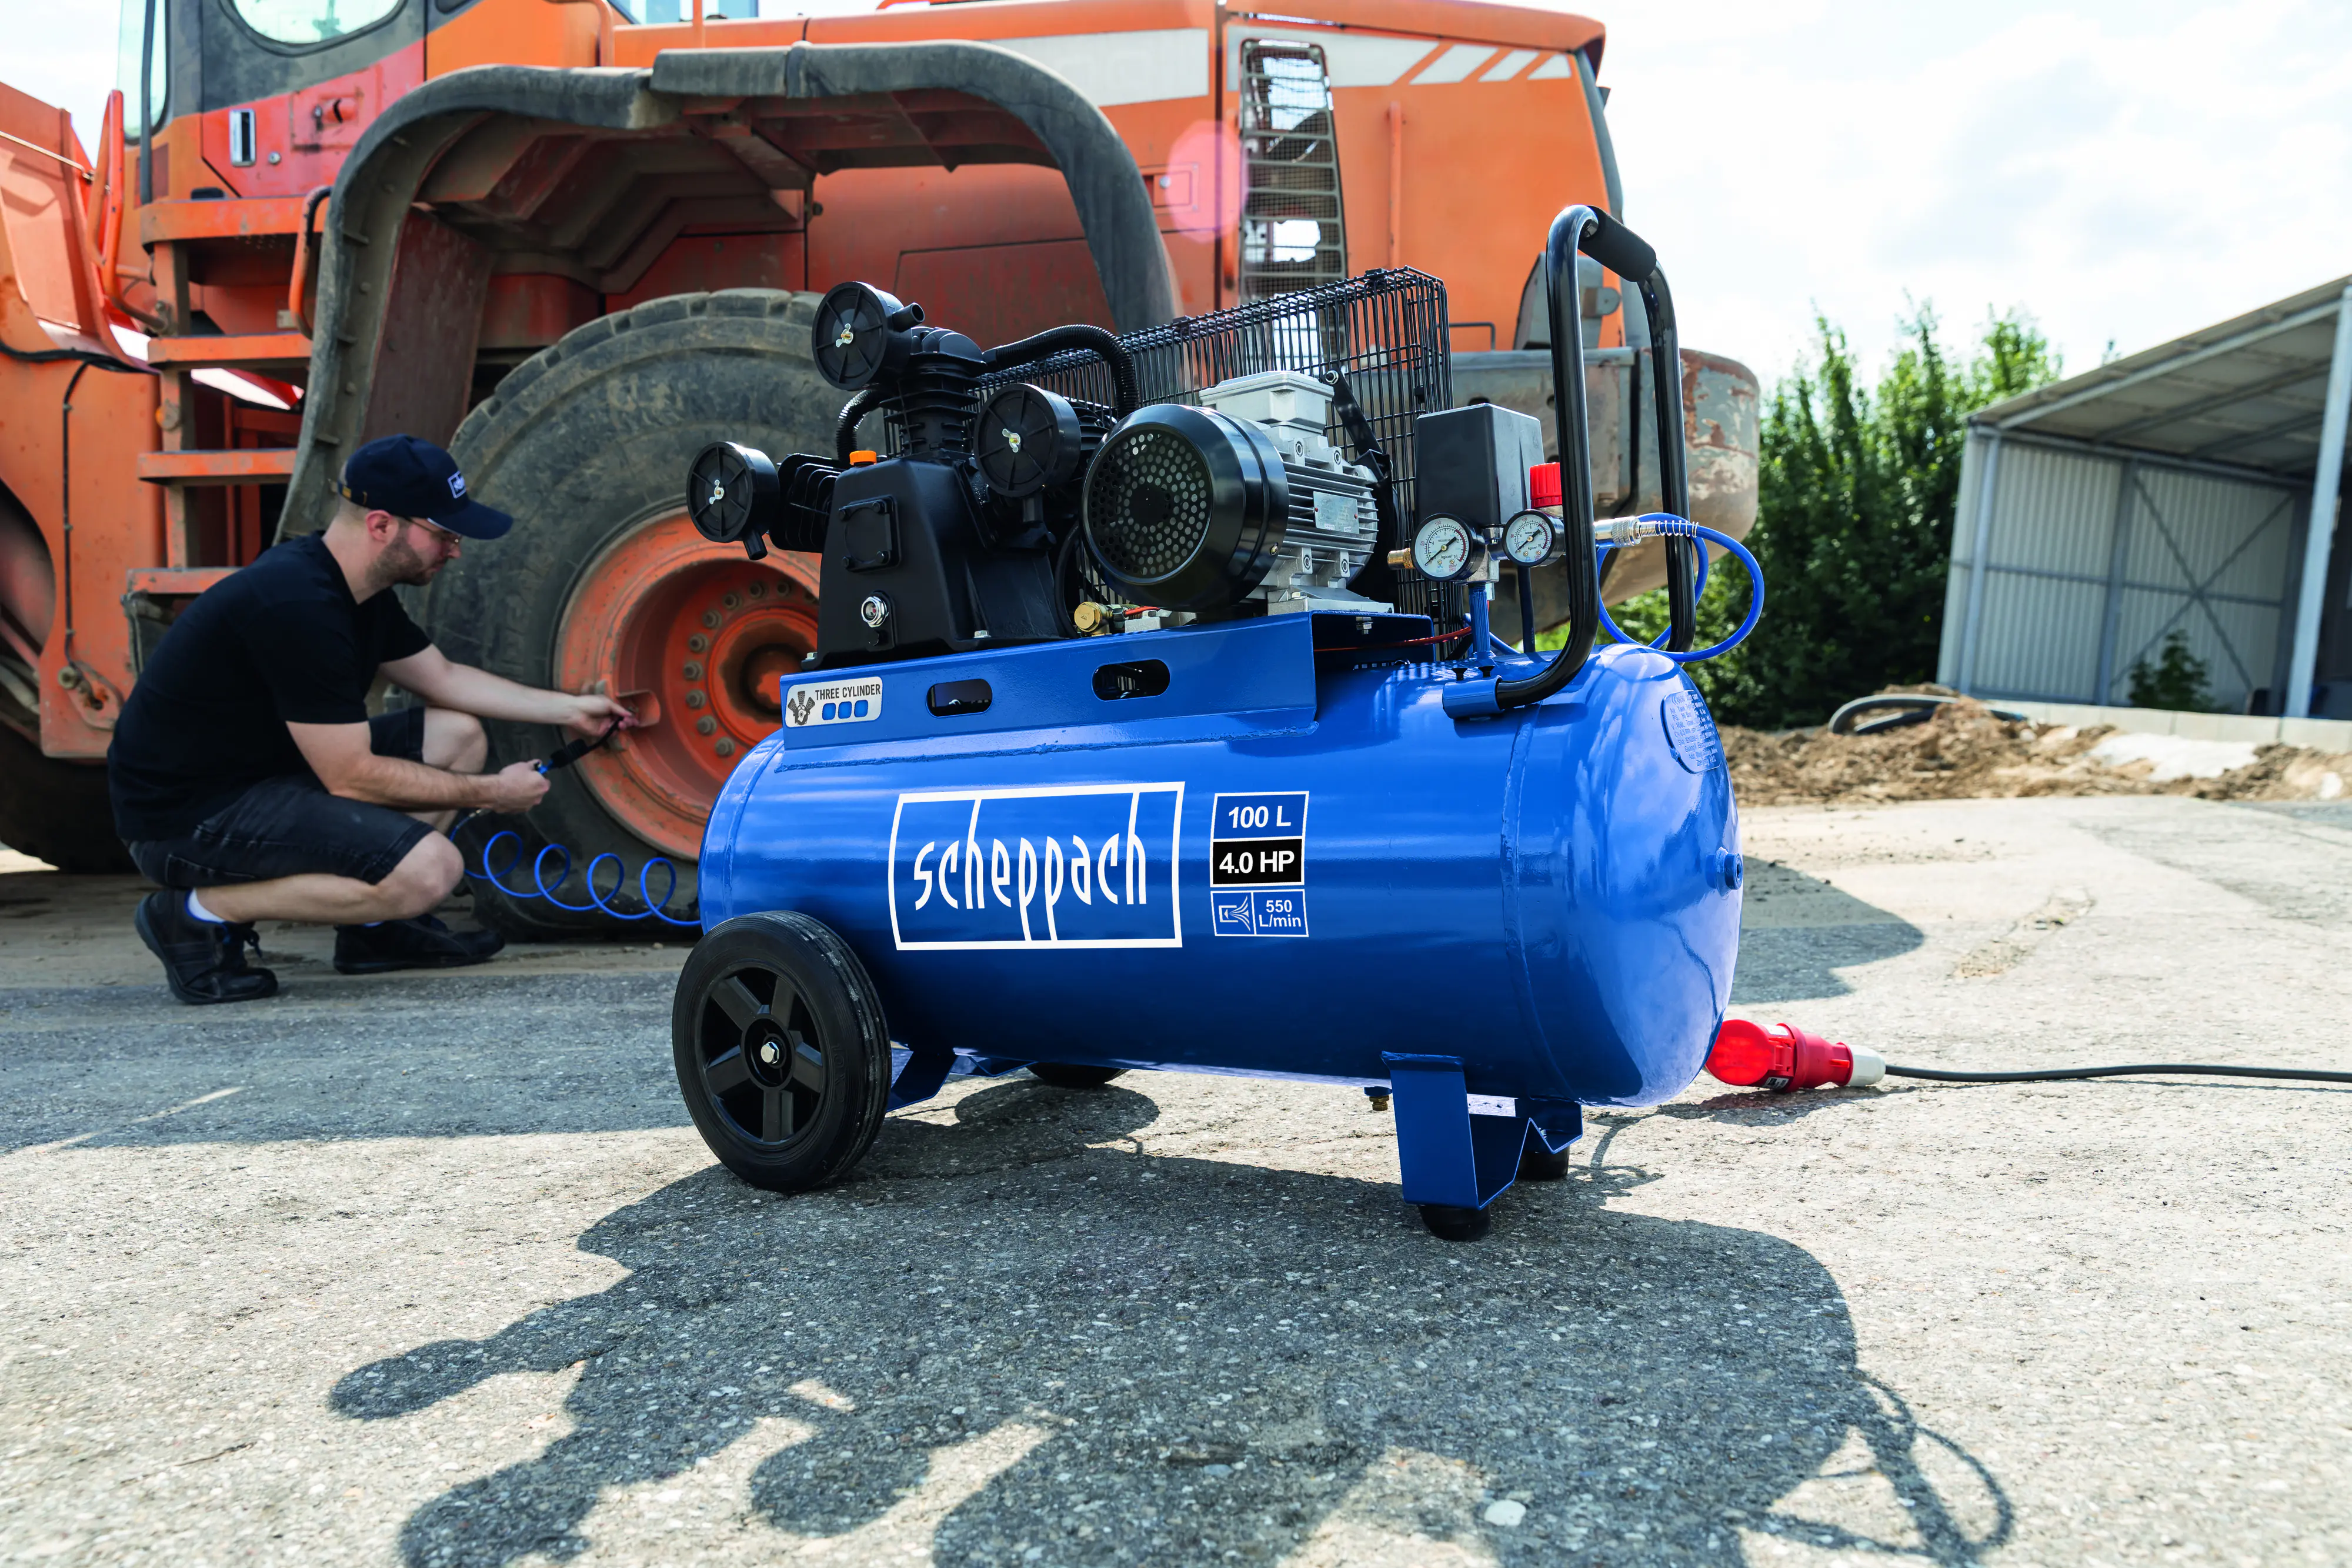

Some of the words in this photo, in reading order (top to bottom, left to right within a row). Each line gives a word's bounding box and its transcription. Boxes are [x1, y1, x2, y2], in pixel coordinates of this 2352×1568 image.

[815, 688, 839, 700] THREE
[842, 684, 880, 698] CYLINDER
[1229, 806, 1269, 828] 100
[1276, 806, 1291, 827] L
[914, 792, 1147, 941] scheppach
[1219, 852, 1253, 874] 4.0
[1260, 850, 1295, 873] HP
[1266, 900, 1292, 913] 550
[1259, 914, 1301, 927] L/min
